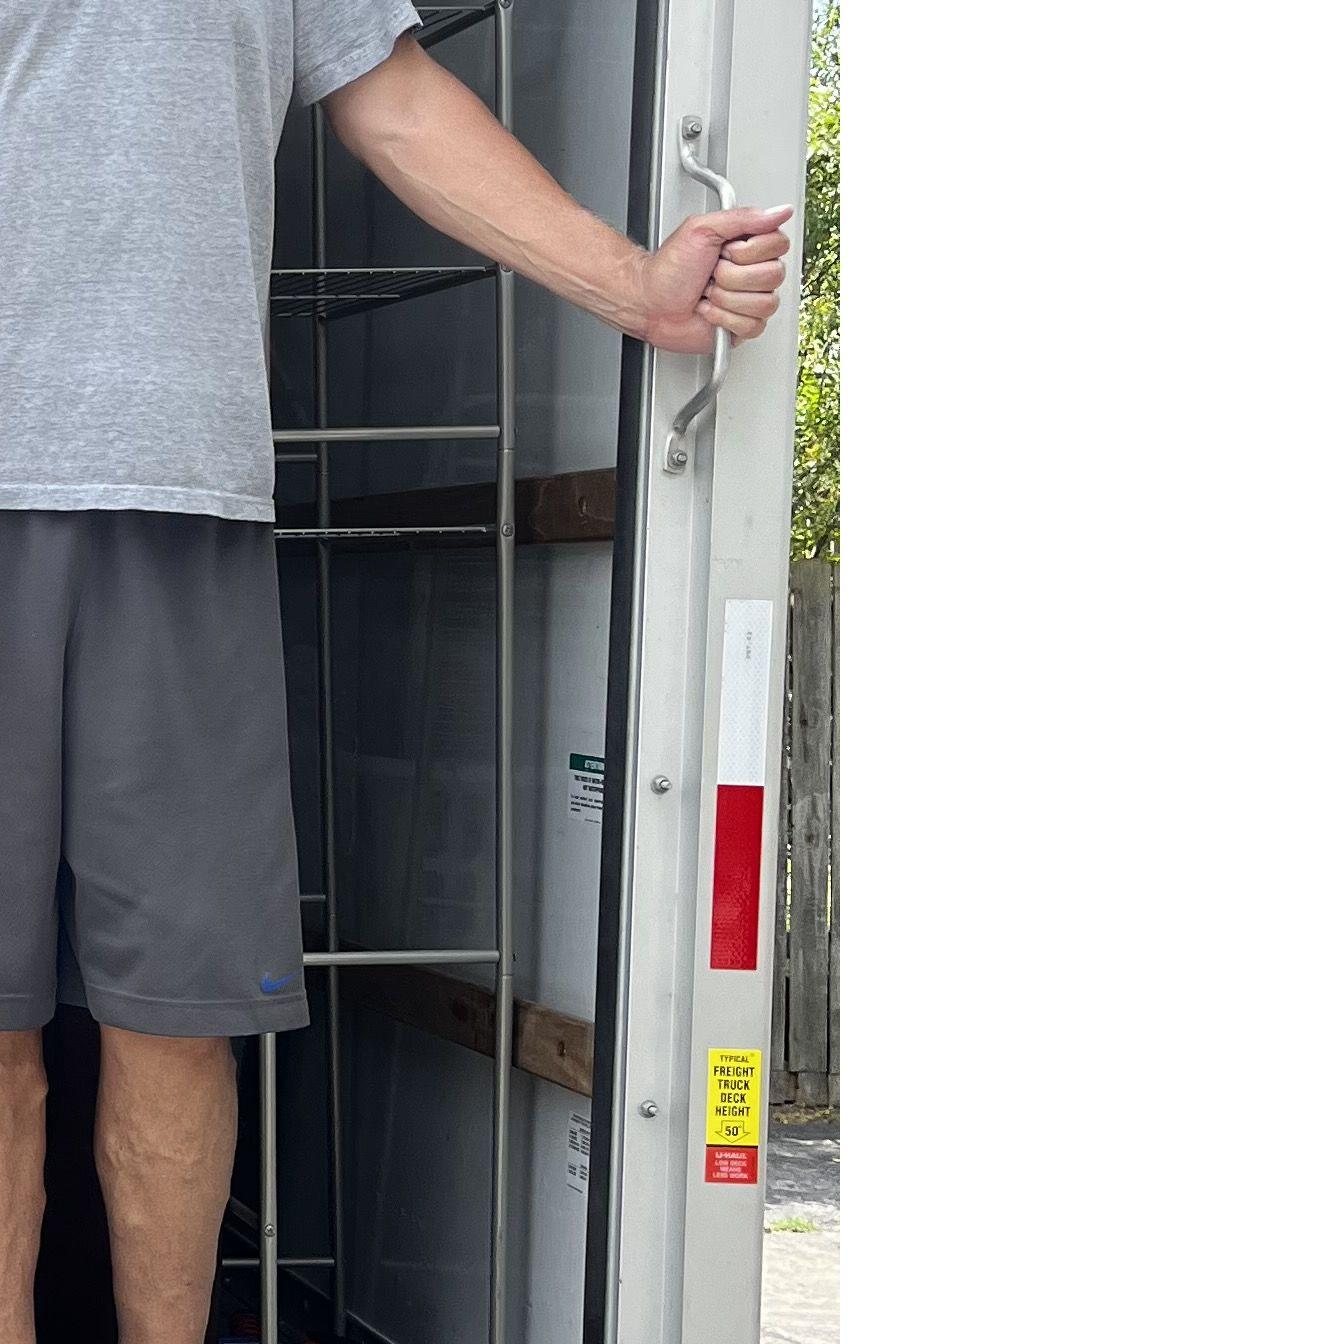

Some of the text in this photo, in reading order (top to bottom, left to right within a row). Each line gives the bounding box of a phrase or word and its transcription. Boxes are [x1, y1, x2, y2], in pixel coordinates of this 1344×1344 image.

[719, 1055, 750, 1064] TYPICAL
[713, 1066, 755, 1078] FREIGHT
[717, 1079, 750, 1091] TRUCK
[720, 1093, 747, 1104] DECK
[715, 1106, 751, 1117] HEIGHT
